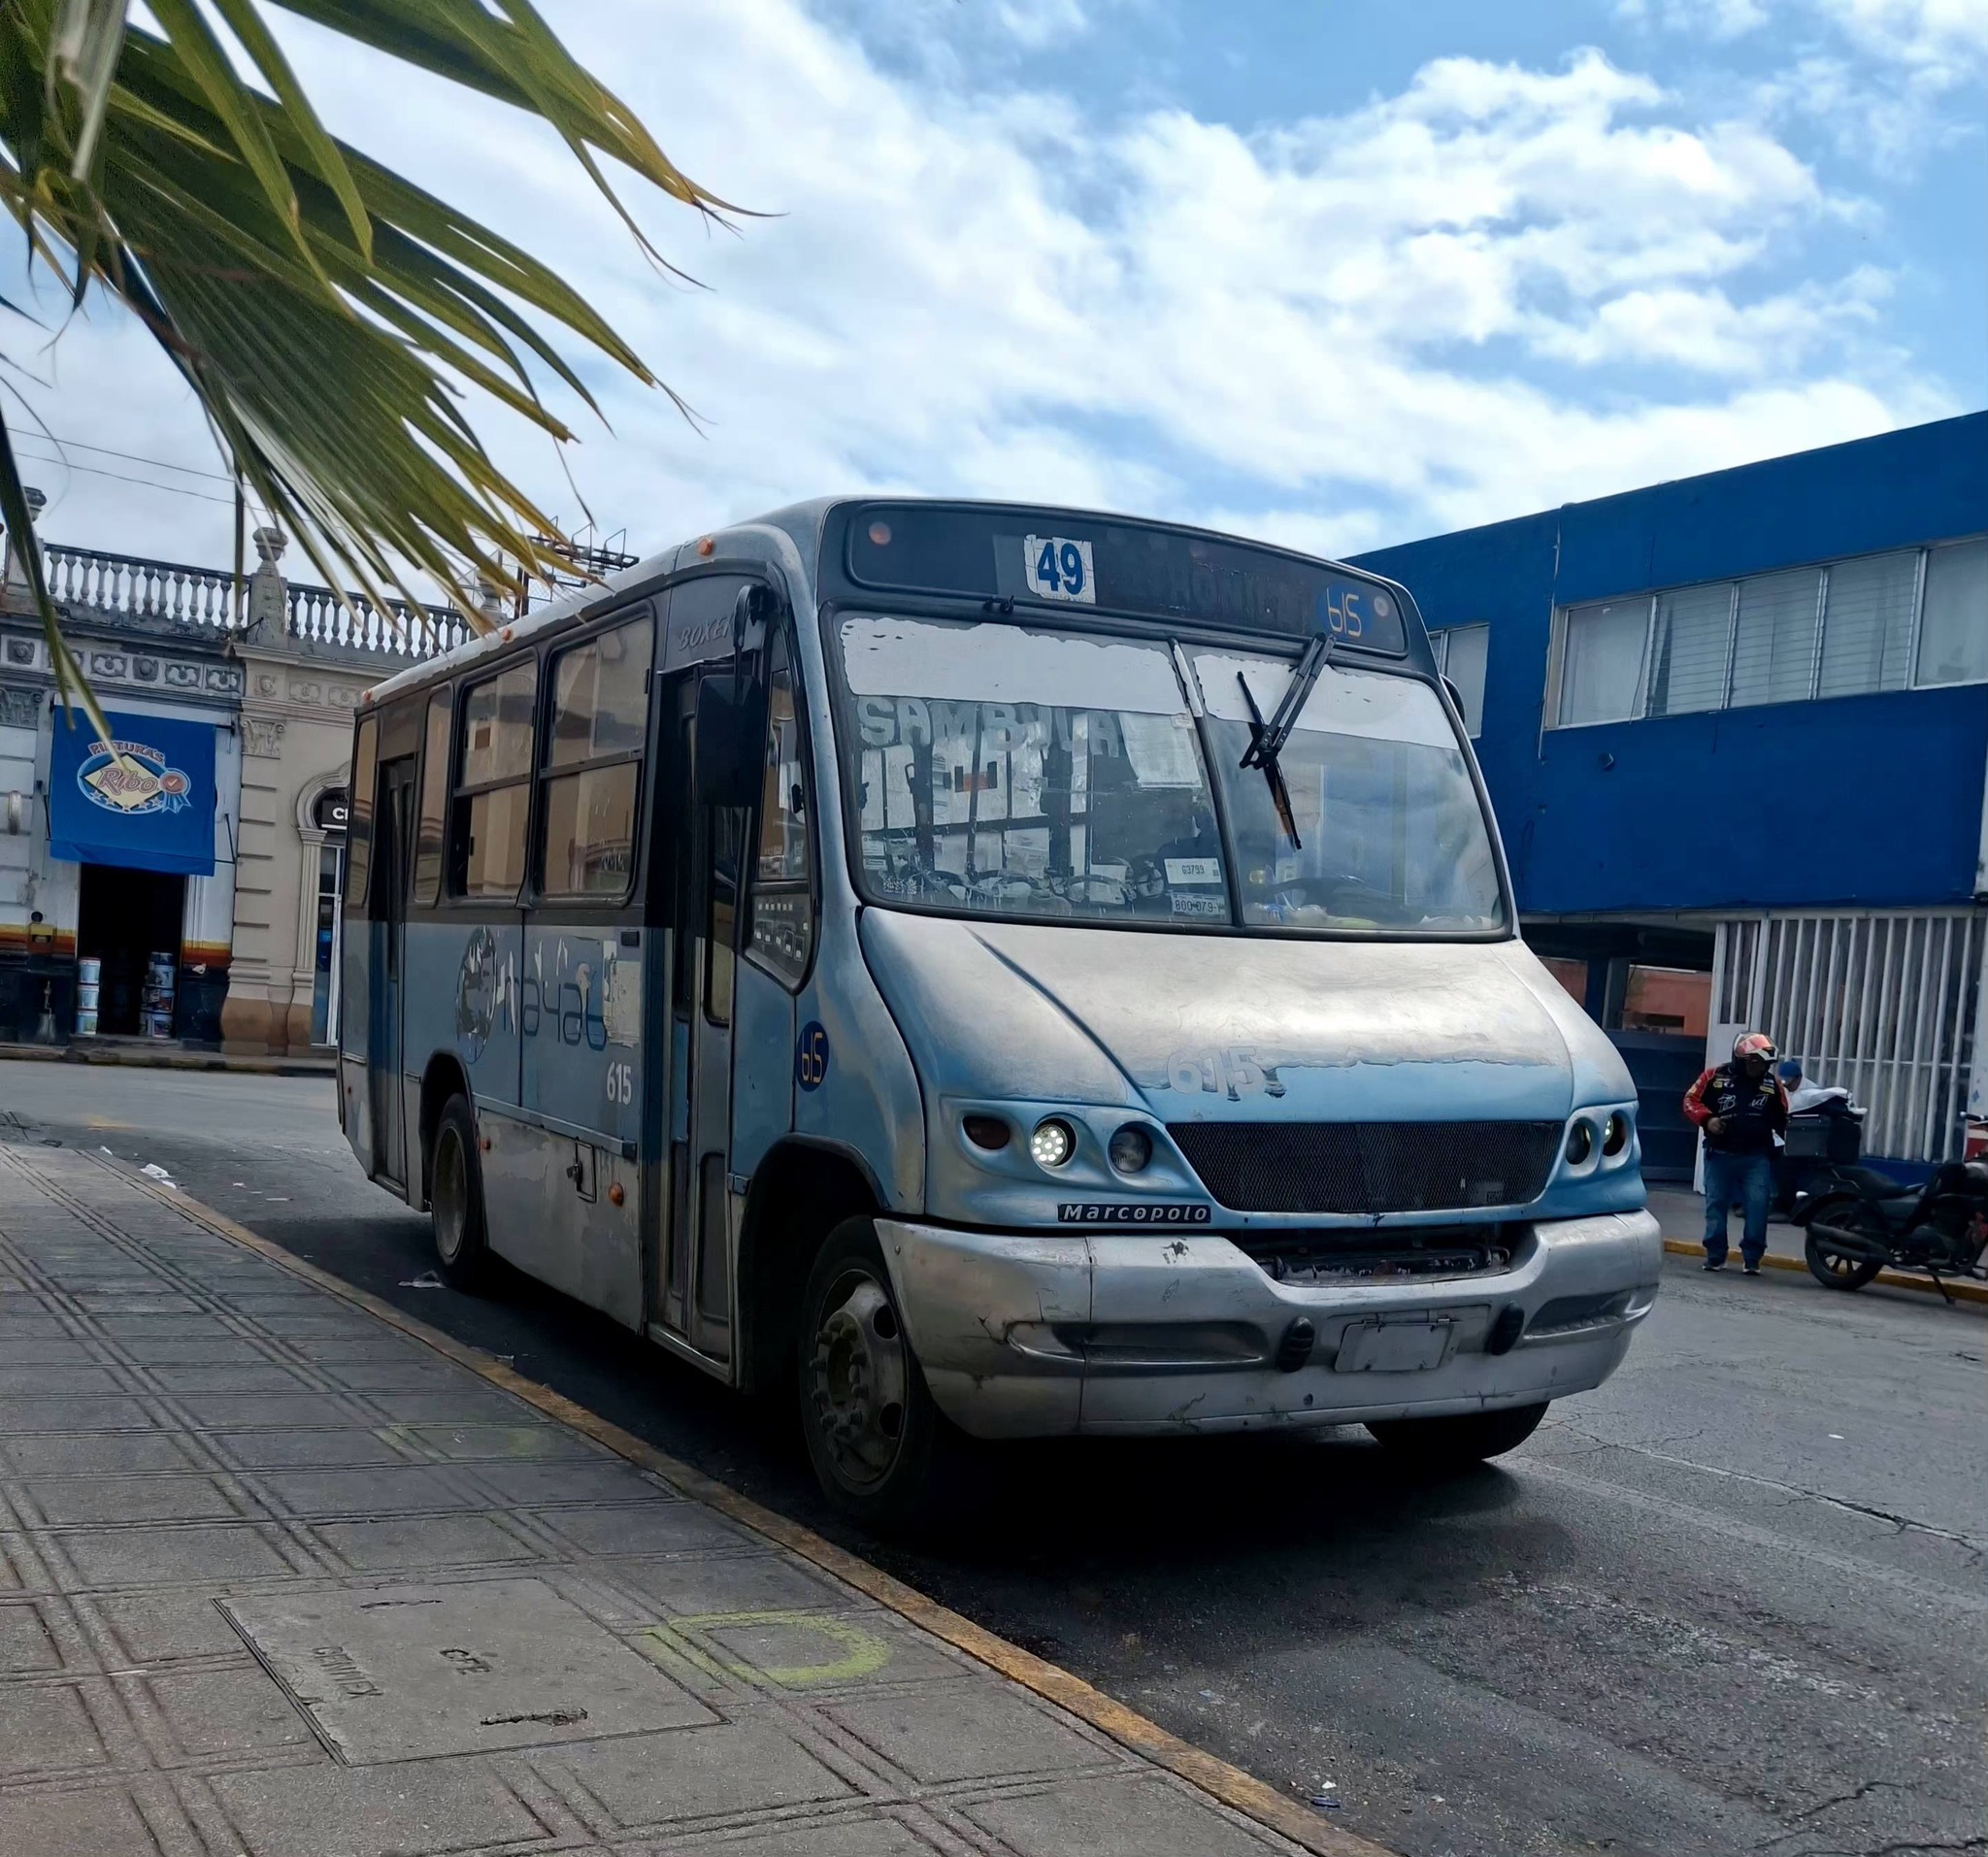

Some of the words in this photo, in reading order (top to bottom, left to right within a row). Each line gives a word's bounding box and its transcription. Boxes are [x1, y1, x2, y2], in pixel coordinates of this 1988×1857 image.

[1037, 542, 1084, 595] 49
[1326, 587, 1362, 637] 615
[89, 741, 164, 763] PITURAS
[802, 1032, 823, 1083] 615
[1167, 1045, 1265, 1095] 615
[607, 1060, 632, 1106] 615
[1063, 1205, 1208, 1222] Marcopolo
